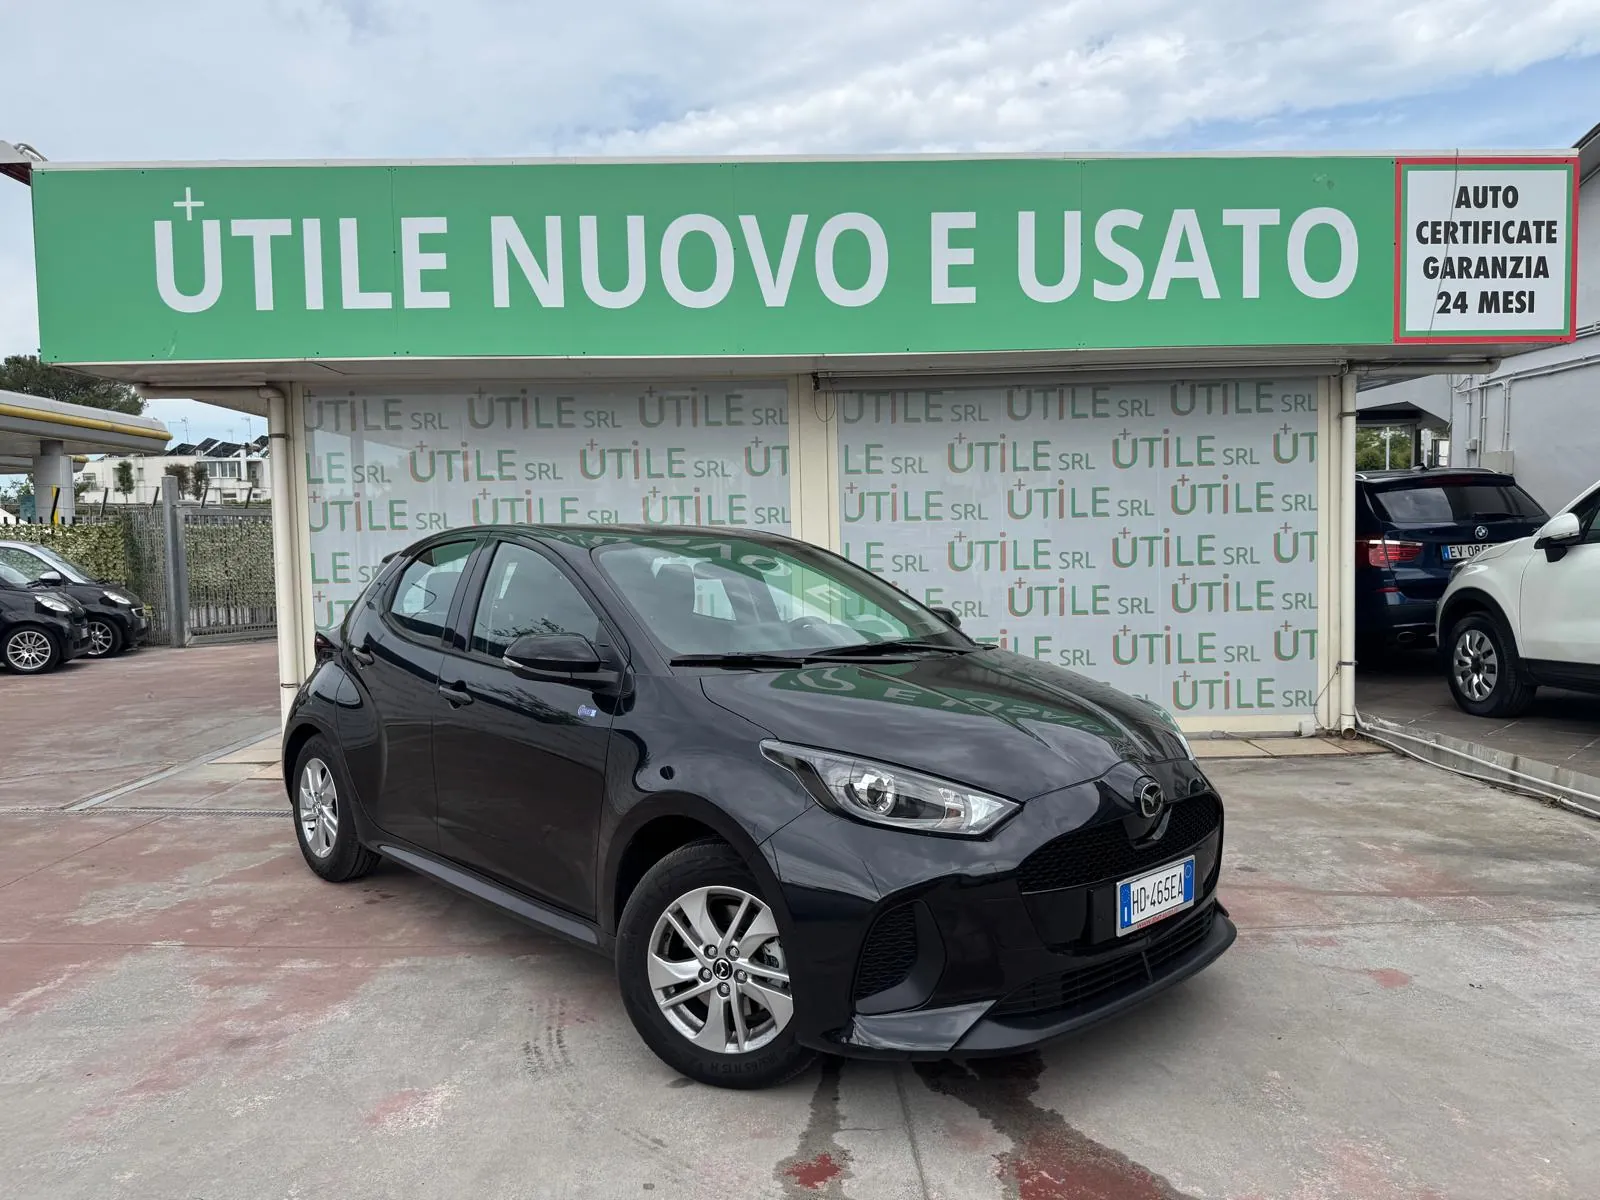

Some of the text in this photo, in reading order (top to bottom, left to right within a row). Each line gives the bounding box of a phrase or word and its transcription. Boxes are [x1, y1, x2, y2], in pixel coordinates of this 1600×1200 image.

[1455, 185, 1519, 209] AUTO
[1415, 220, 1558, 245] CERTIFICATE
[490, 212, 889, 309] NUOVO
[931, 212, 976, 304] E
[1018, 206, 1359, 303] USATO
[1422, 256, 1550, 280] GARANZIA
[1436, 290, 1535, 314] 24 MESI
[1117, 399, 1155, 417] SRL
[1281, 394, 1317, 412] SRL
[410, 412, 449, 430] SRL
[583, 410, 622, 428] SRL
[751, 408, 789, 426] SRL
[951, 405, 990, 422] SRL
[891, 456, 928, 474] SRL
[1058, 453, 1096, 470] SRL
[1222, 448, 1260, 466] SRL
[353, 465, 392, 483] SRL
[524, 463, 563, 481] SRL
[693, 460, 732, 478] SRL
[951, 503, 988, 521] SRL
[1117, 499, 1155, 517] SRL
[1281, 494, 1317, 512] SRL
[415, 512, 454, 530] SRL
[754, 507, 791, 524] SRL
[891, 554, 929, 573] SRL
[1058, 551, 1096, 569] SRL
[1223, 547, 1261, 565] SRL
[951, 600, 989, 618] SRL
[1117, 597, 1155, 615] SRL
[1281, 593, 1318, 610] SRL
[1059, 649, 1096, 666] SRL
[1223, 645, 1261, 663] SRL
[1281, 690, 1317, 707] SRL
